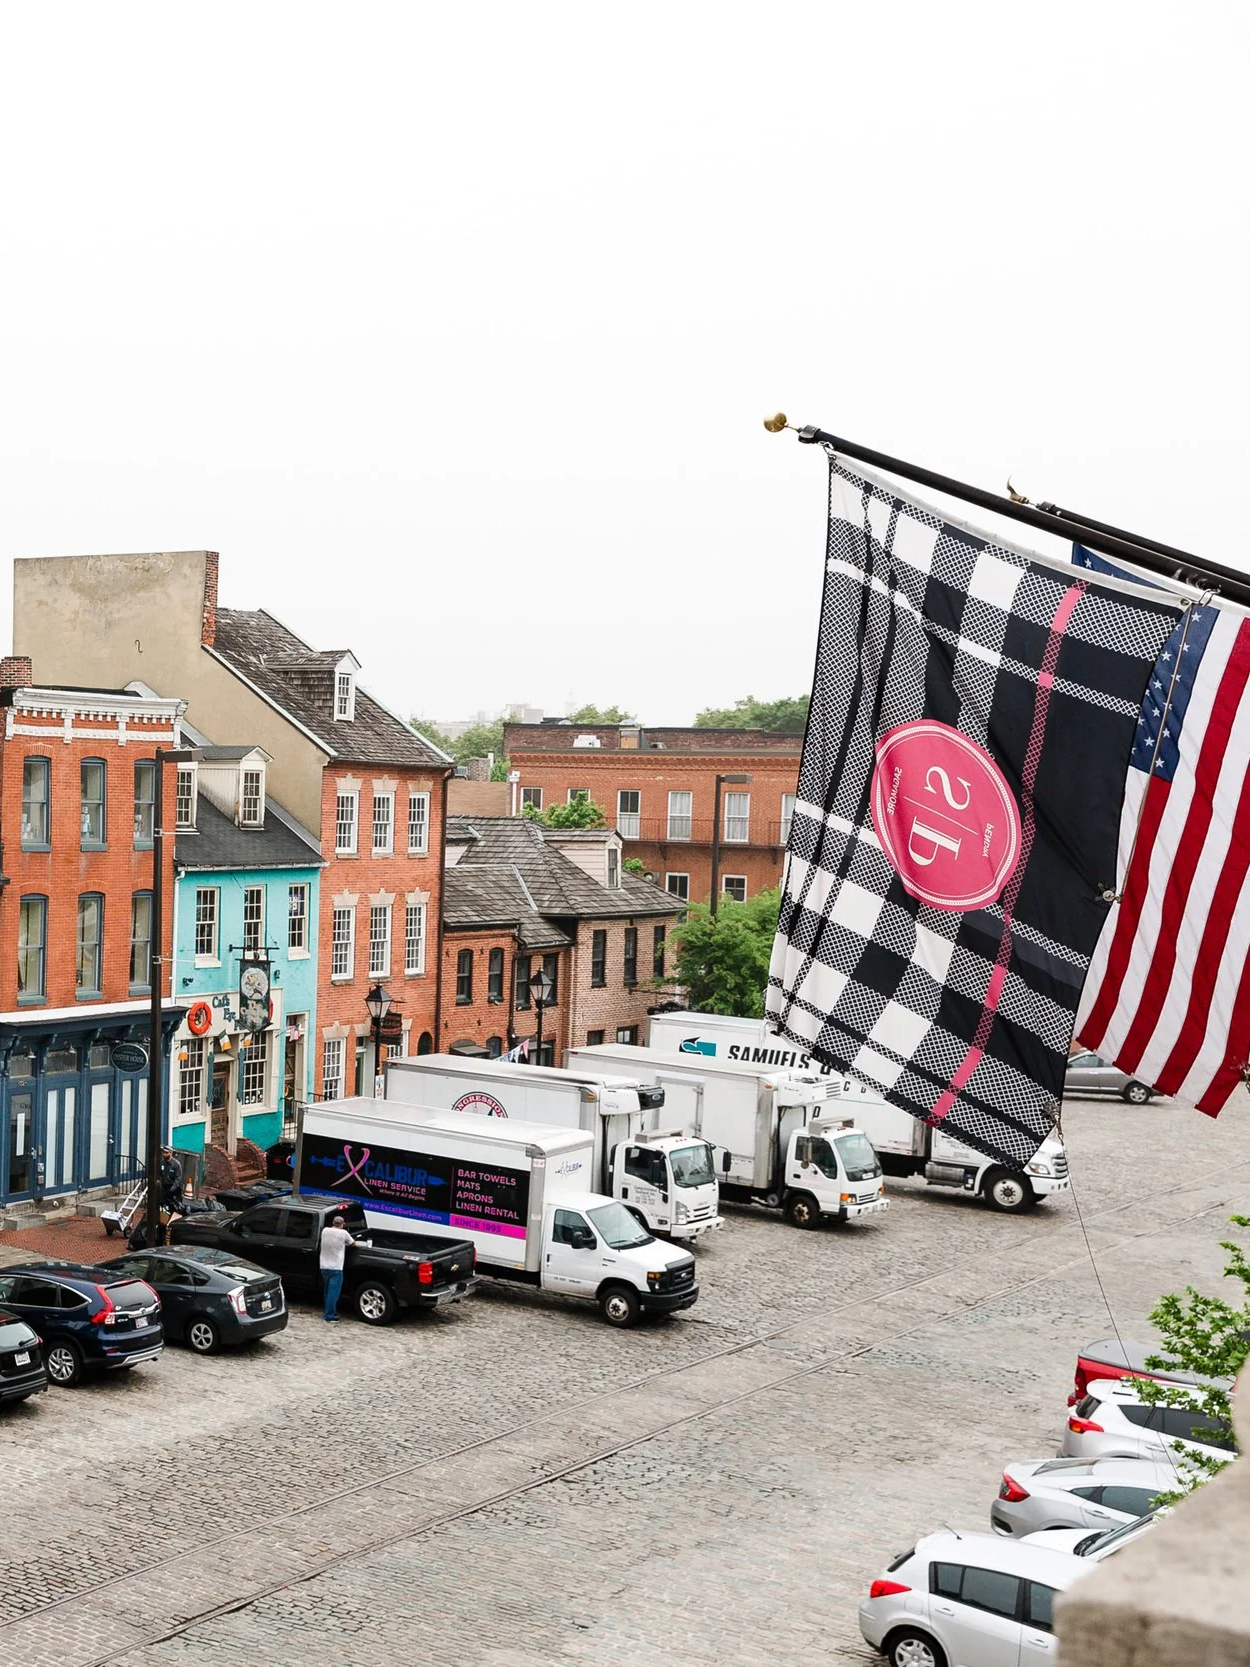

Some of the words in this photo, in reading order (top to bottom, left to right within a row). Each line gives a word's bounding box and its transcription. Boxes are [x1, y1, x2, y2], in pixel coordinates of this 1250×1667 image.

[457, 1169, 476, 1179] BAR
[478, 1173, 516, 1186] TOWELS
[364, 1178, 388, 1190] LINEN
[391, 1182, 427, 1195] SERVICE
[457, 1180, 481, 1191] MATS
[456, 1191, 494, 1203] APRONS
[455, 1201, 482, 1213] LINEN
[484, 1206, 520, 1220] RENTAL
[454, 1218, 480, 1229] SINCE
